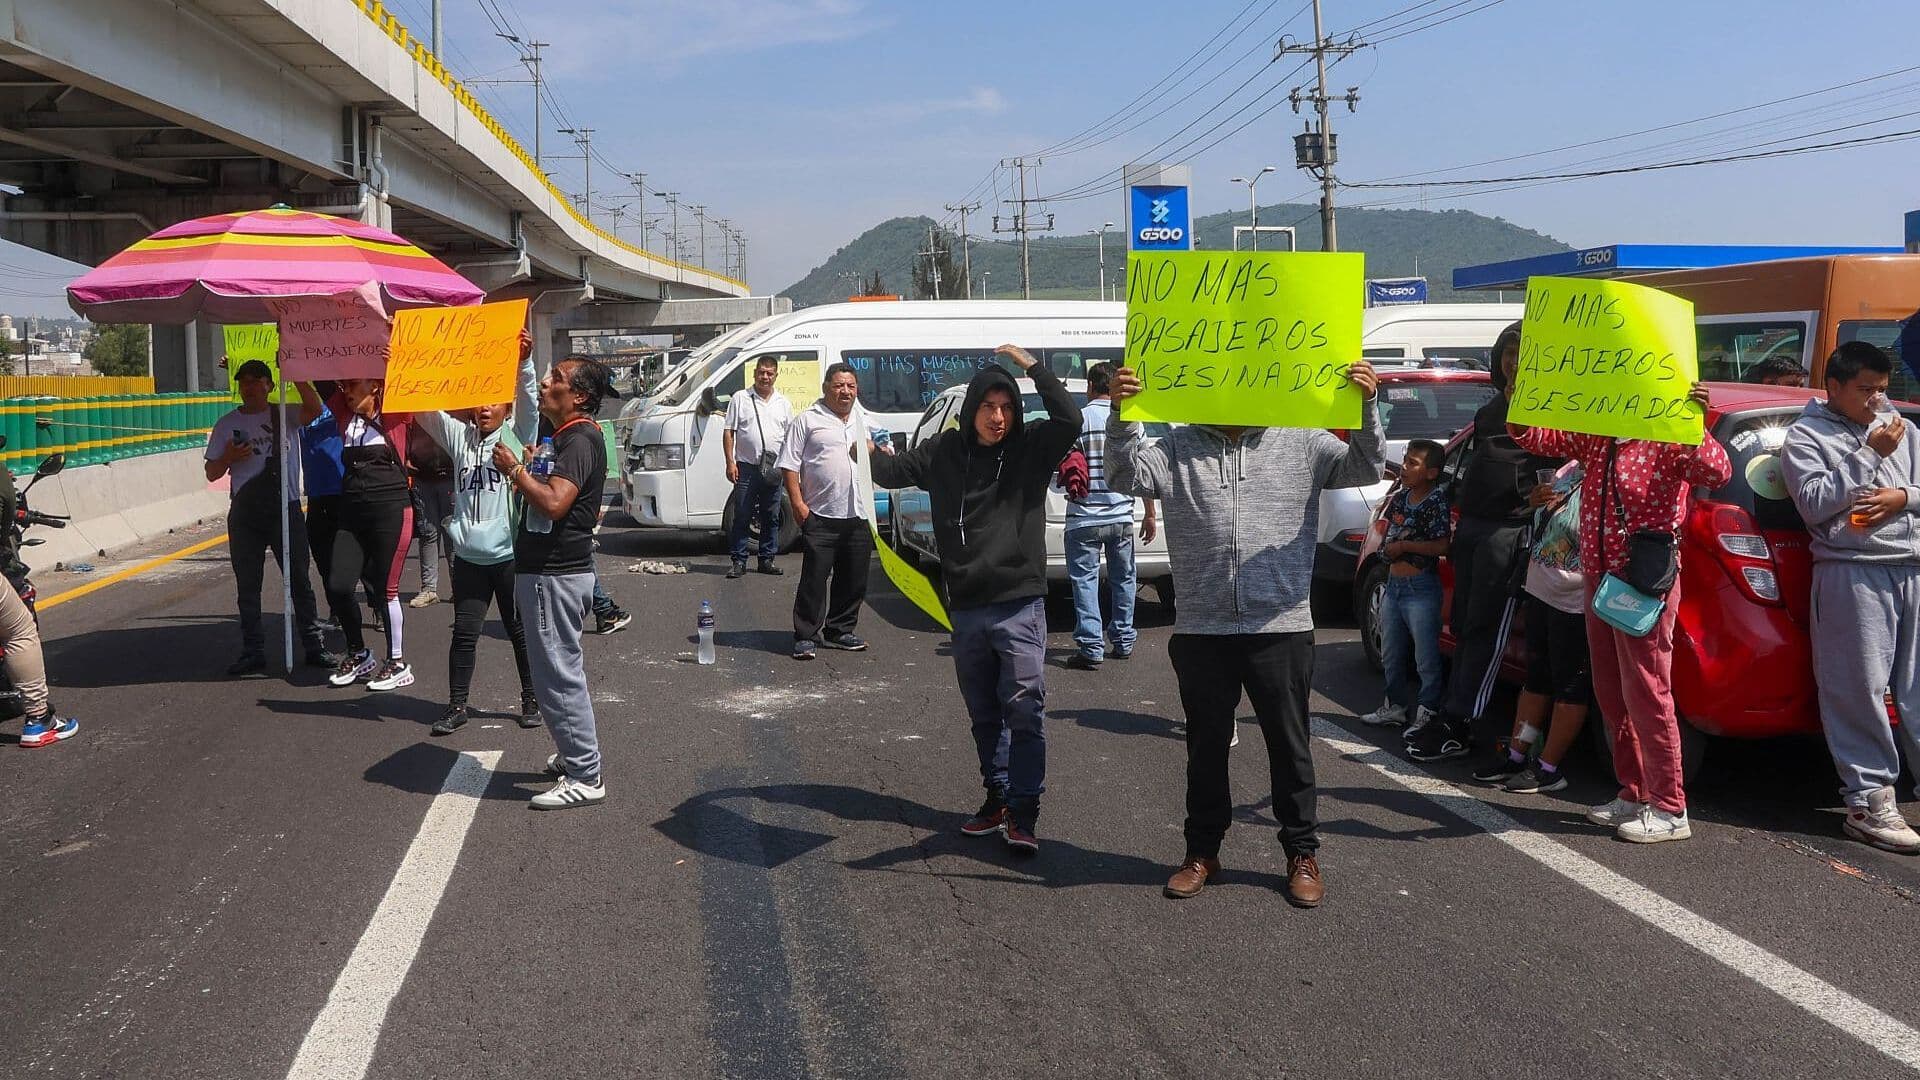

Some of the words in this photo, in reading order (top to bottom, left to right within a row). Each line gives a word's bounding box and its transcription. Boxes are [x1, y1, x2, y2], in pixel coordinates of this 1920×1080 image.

[1140, 227, 1183, 241] G500
[1584, 249, 1612, 265] G500
[1129, 258, 1177, 304] NO
[1192, 258, 1278, 304] MAS
[1388, 287, 1416, 296] G500
[1525, 288, 1550, 322] NO
[1563, 293, 1625, 329] MAS
[288, 316, 368, 334] MUERTES
[391, 314, 422, 347] NO
[432, 311, 486, 344] MAS
[1127, 312, 1328, 358] PASAJEROS
[227, 330, 246, 351] NO
[303, 343, 383, 360] PASAJEROS
[392, 335, 515, 372] PASAJEROS
[848, 356, 870, 371] NO
[921, 354, 1000, 371] MUERTES
[1519, 336, 1676, 380] PASAJEROS
[780, 366, 806, 377] MAS
[921, 371, 945, 386] DE
[1136, 360, 1350, 392] ASESINADOS
[385, 373, 504, 397] ASESINADOS
[1510, 380, 1696, 420] ASESINADOS
[459, 464, 501, 493] GAP
